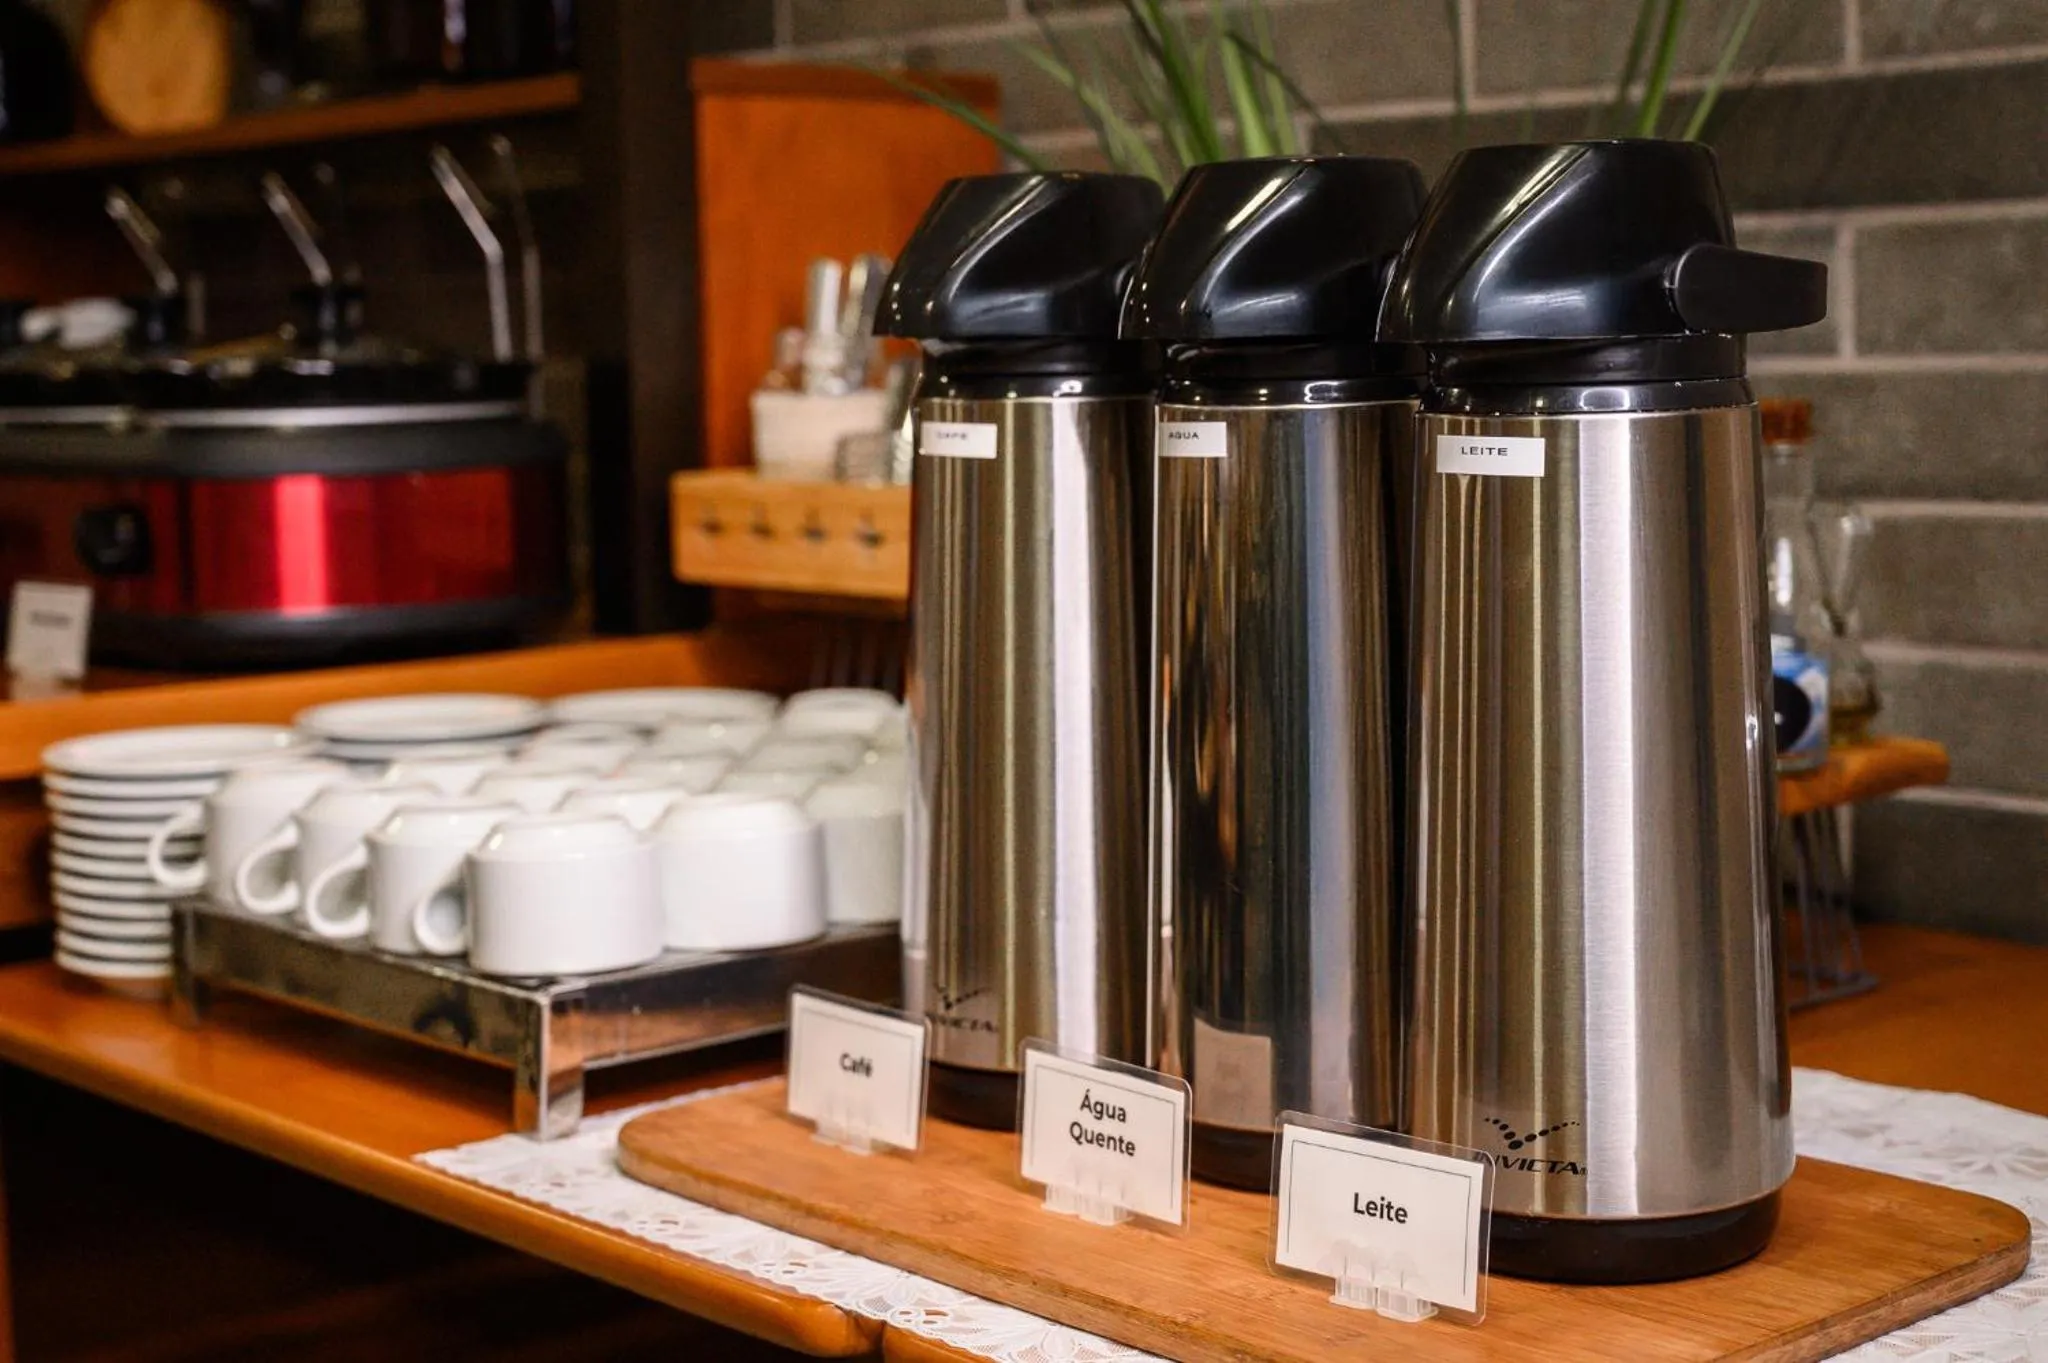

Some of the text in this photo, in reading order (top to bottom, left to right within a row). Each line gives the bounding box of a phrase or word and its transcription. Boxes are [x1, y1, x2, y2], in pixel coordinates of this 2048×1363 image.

[1461, 446, 1508, 456] LEITE
[839, 1052, 873, 1078] Café
[1080, 1088, 1126, 1123] Água
[1069, 1121, 1135, 1157] Quente
[1353, 1192, 1408, 1224] Leite
